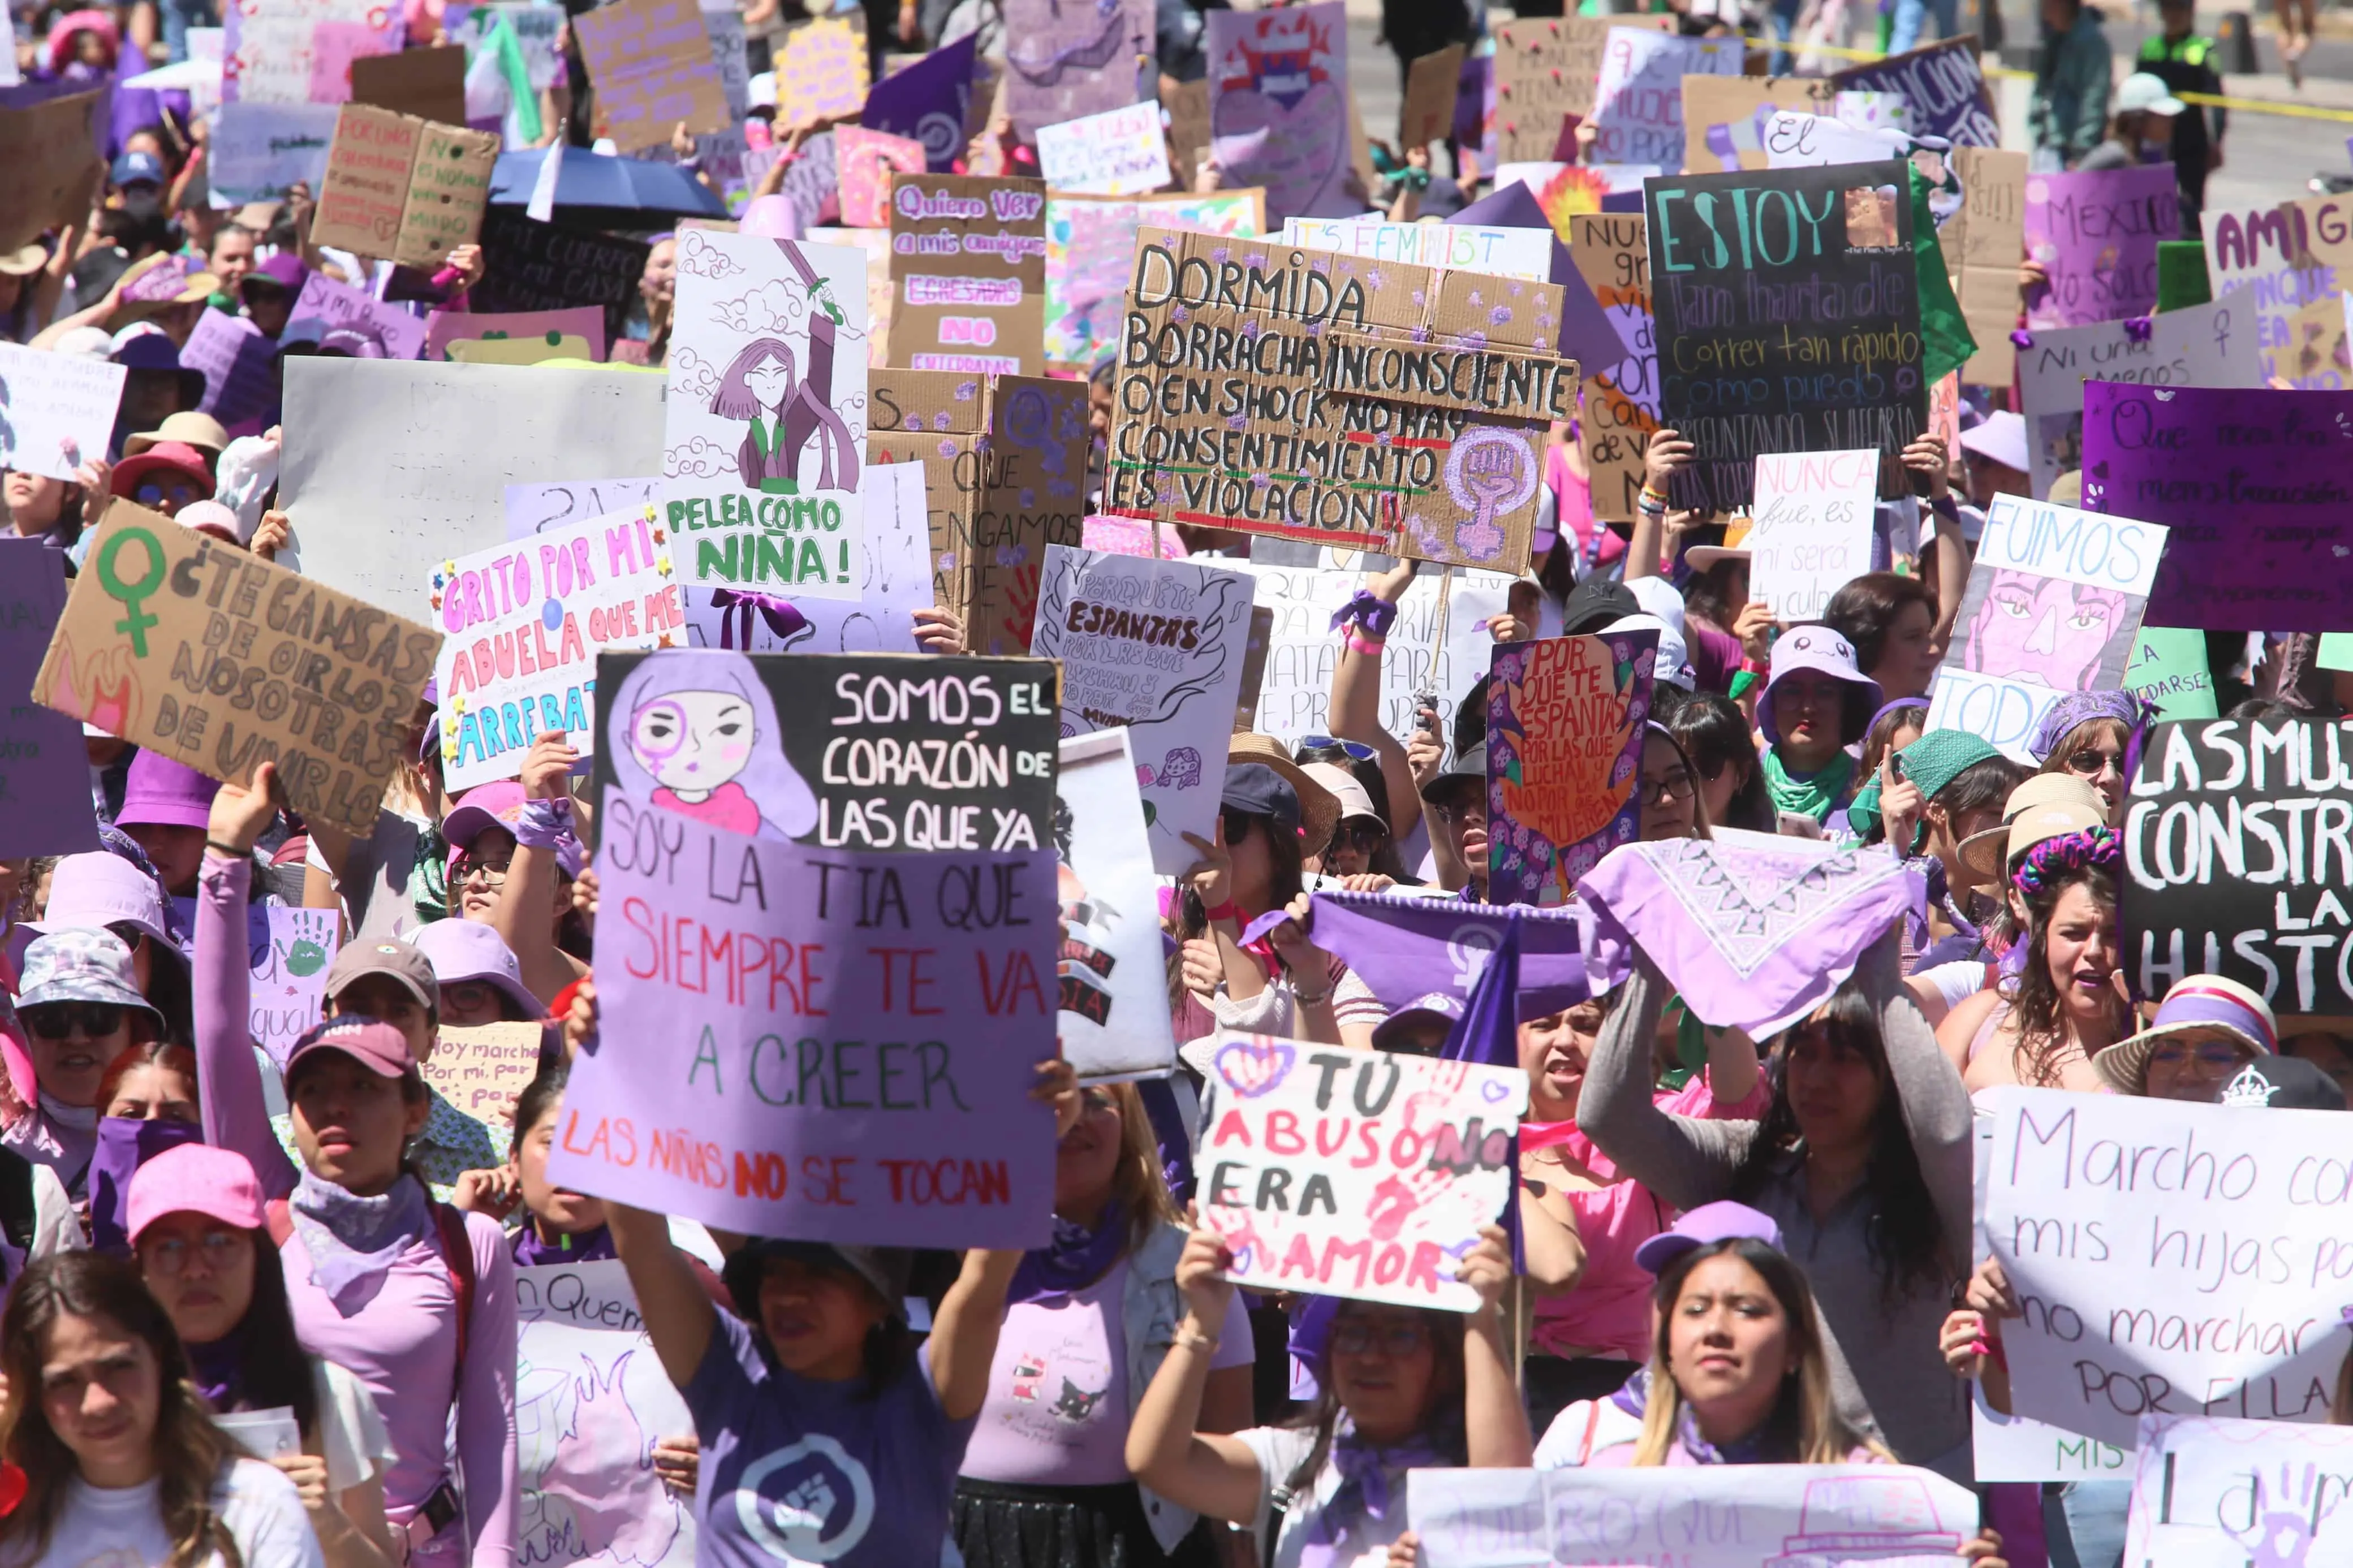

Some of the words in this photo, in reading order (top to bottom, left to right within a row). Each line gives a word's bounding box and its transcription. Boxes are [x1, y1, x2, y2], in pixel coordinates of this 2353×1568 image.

[1769, 116, 1816, 155] El
[899, 187, 984, 219] Quiero
[993, 191, 1041, 218] Ver
[919, 229, 959, 252] mis
[1354, 224, 1505, 266] FEMINIST
[1657, 187, 1834, 271] ESTOY
[2217, 204, 2353, 270] AMIG
[908, 277, 1020, 303] EGRESADAS
[1658, 274, 1734, 333] Tan
[1747, 272, 1846, 323] harta
[1853, 261, 1904, 316] de
[2220, 265, 2338, 308] ANQUE
[942, 318, 994, 343] NO
[1673, 336, 1766, 372] Correr
[1778, 325, 1829, 364] tan
[1842, 322, 1917, 381] rápido
[1123, 374, 1153, 414] O
[1160, 378, 1212, 416] EN
[1343, 395, 1387, 433] NO
[1397, 404, 1466, 443] HAY
[1664, 376, 1768, 419] Como
[1785, 365, 1884, 412] puedo
[953, 451, 1020, 491] QUE
[1593, 434, 1622, 463] de
[1758, 454, 1877, 492] NUNCA
[667, 494, 753, 534] PELEA
[757, 495, 843, 532] COMO
[1113, 470, 1157, 509] ES
[1826, 500, 1854, 522] es
[928, 511, 1079, 551] ENGAMOS
[1756, 540, 1784, 569] ni
[1790, 539, 1848, 570] será
[1981, 500, 2144, 584] FUIMOS
[443, 550, 531, 634] GRITO
[540, 537, 596, 599] POR
[606, 517, 655, 577] MI
[1257, 572, 1329, 601] QUE
[1067, 601, 1198, 650] ESPANTAS
[1754, 589, 1780, 617] tu
[203, 611, 258, 660] DE
[447, 611, 585, 699] ABUELA
[589, 599, 638, 643] QUE
[645, 584, 684, 632] ME
[1101, 642, 1143, 664] LAS
[1144, 649, 1183, 673] QUE
[1532, 638, 1586, 675] POR
[832, 673, 1001, 727] SOMOS
[1011, 683, 1051, 716] EL
[1080, 687, 1117, 709] POR
[1141, 675, 1160, 694] Y
[1517, 671, 1566, 709] QUÉ
[1571, 666, 1601, 696] TE
[153, 695, 209, 751] DE
[171, 642, 406, 777] NOSOTRAS
[1521, 693, 1630, 739] ESPANTAS
[823, 731, 1009, 788] CORAZÓN
[1018, 751, 1051, 777] DE
[1520, 741, 1548, 763] POR
[1552, 741, 1581, 761] LAS
[1585, 737, 1613, 757] QUE
[1522, 762, 1583, 787] LUCHAN
[2130, 720, 2247, 795] LAS
[1508, 786, 1540, 811] NO
[1545, 786, 1568, 809] POR
[1539, 793, 1619, 843] MUEREN
[820, 797, 896, 848] LAS
[904, 801, 980, 849] QUE
[993, 806, 1037, 852] YA
[611, 798, 685, 884] SOY
[709, 835, 766, 910] LA
[805, 859, 908, 929] TIA
[938, 862, 1031, 930] QUE
[2275, 890, 2351, 930] LA
[622, 896, 828, 1016] SIEMPRE
[867, 949, 942, 1014] TE
[977, 949, 1046, 1016] VA
[689, 1024, 723, 1095] A
[751, 1034, 973, 1112] CREER
[563, 1110, 638, 1166] LAS
[649, 1128, 726, 1190] NIÑAS
[735, 1151, 787, 1200] NO
[802, 1156, 858, 1205] SE
[876, 1157, 1011, 1205] TOCAN
[1213, 1109, 1420, 1169] ABUSO
[1429, 1117, 1510, 1177] NO
[2011, 1106, 2257, 1200] Marcho
[2289, 1154, 2353, 1206] co
[1210, 1161, 1338, 1216] ERA
[1279, 1232, 1440, 1294] AMOR
[2013, 1212, 2109, 1261] mis
[2152, 1208, 2291, 1293] hijas
[2019, 1294, 2083, 1342] no
[2109, 1307, 2315, 1355] marchar
[2075, 1361, 2173, 1415] POR
[2057, 1439, 2124, 1470] MIS
